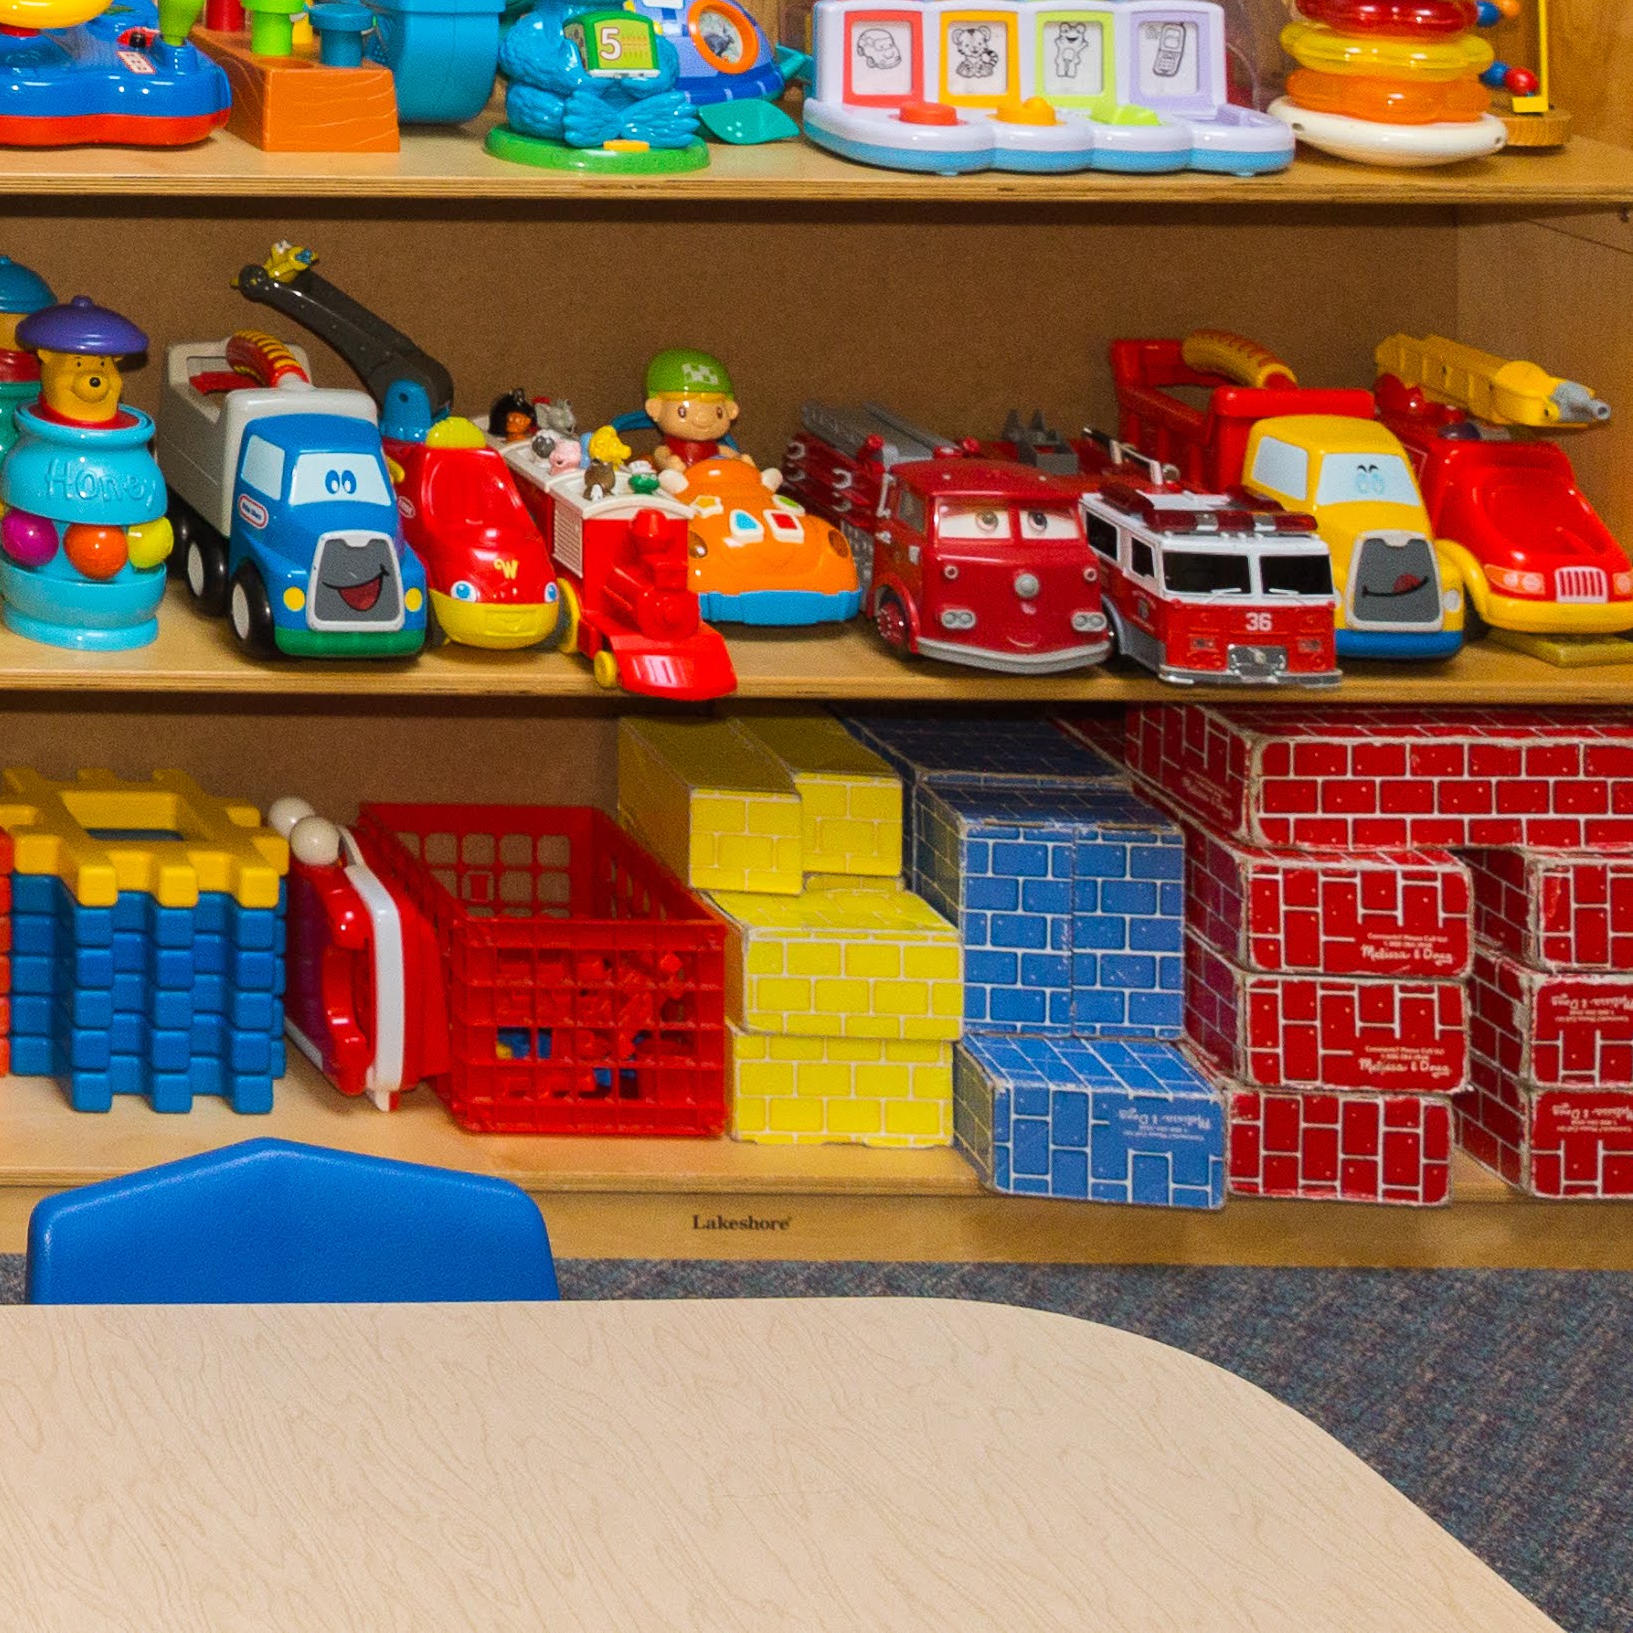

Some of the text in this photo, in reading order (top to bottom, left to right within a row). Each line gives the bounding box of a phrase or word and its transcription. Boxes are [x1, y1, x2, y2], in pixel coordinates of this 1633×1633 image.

[600, 26, 623, 61] 5
[494, 558, 519, 580] W
[1246, 612, 1272, 631] 36
[1360, 944, 1412, 961] Melissa
[1422, 948, 1453, 966] Doug
[1359, 1057, 1409, 1074] Melissa
[1419, 1061, 1453, 1079] Doug
[693, 1214, 790, 1231] Lakeshore
